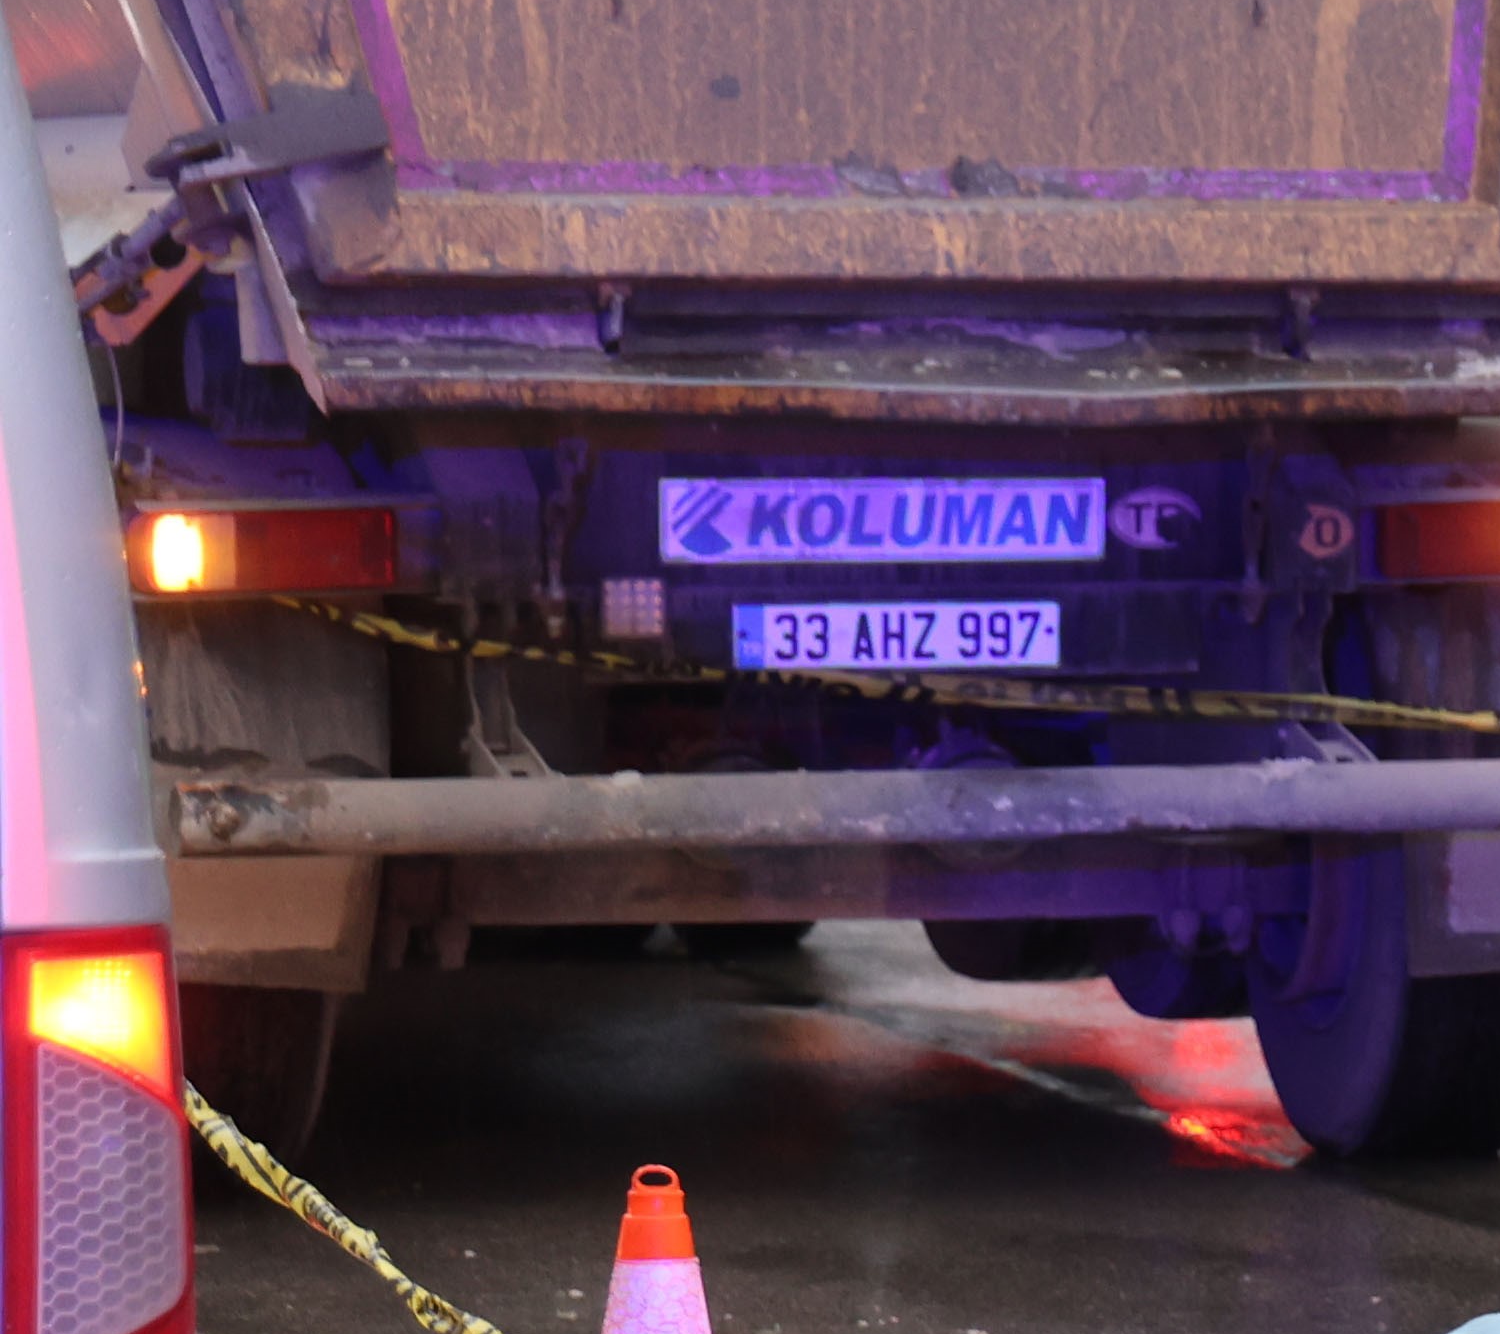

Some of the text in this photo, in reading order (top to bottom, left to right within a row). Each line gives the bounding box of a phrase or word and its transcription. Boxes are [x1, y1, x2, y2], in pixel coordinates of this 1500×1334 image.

[747, 492, 1091, 549] KOLUMAN
[774, 612, 830, 660] 33
[853, 612, 937, 660] AHZ
[957, 611, 1041, 659] 997
